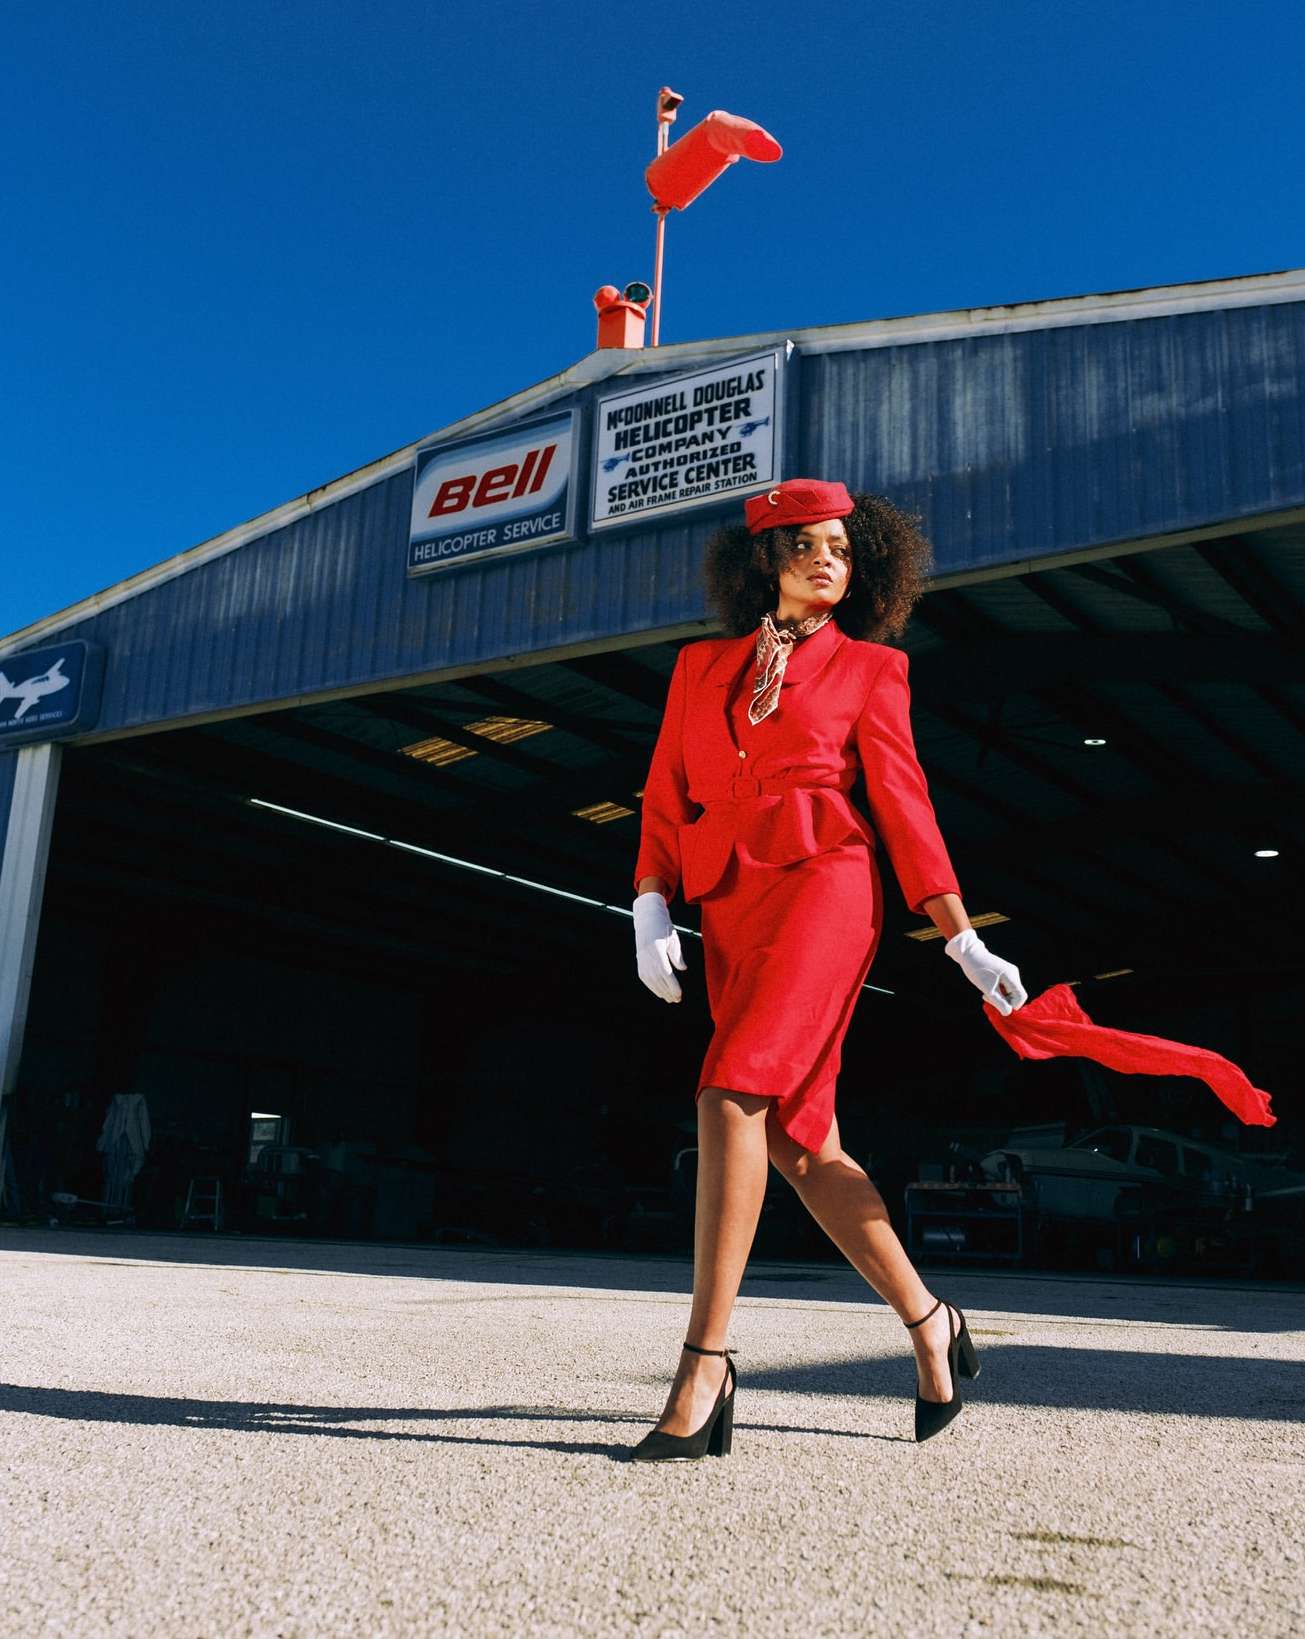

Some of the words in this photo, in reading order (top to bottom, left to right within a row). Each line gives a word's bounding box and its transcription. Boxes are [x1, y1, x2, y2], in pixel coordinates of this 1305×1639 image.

[693, 369, 765, 408] DOUGLAS
[614, 397, 751, 451] HELICOPTER
[631, 426, 732, 462] COMPANY
[428, 443, 557, 519] Bell
[608, 470, 679, 504] SERVICE
[684, 452, 757, 484] CENTER
[625, 441, 741, 479] AUTHORIZED
[608, 503, 626, 515] AND
[628, 499, 644, 511] AIR
[646, 491, 676, 506] FRAME
[679, 483, 711, 498] REPAIR
[714, 471, 758, 490] STATION
[414, 528, 497, 562] HELICOPTER
[503, 512, 561, 540] SERVICE
